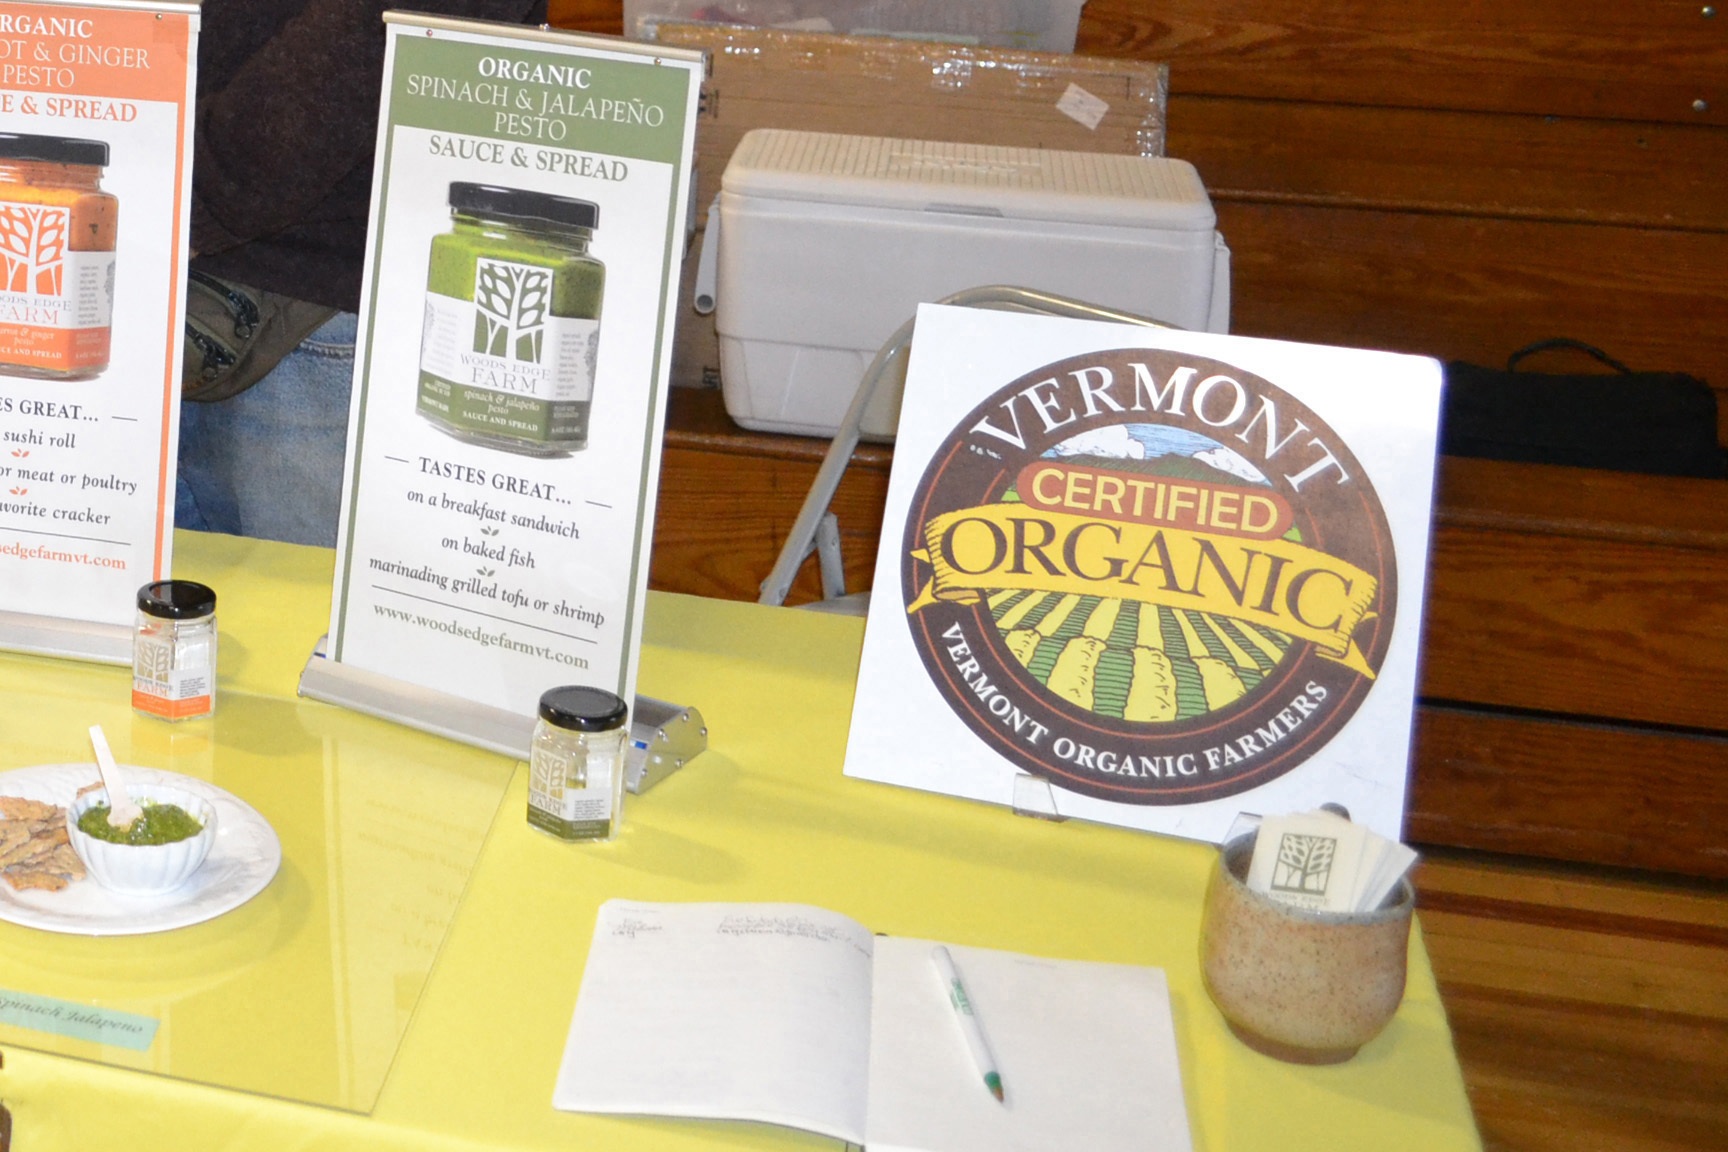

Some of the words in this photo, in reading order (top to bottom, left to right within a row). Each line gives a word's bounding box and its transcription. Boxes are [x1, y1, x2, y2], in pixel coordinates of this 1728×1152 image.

[33, 41, 50, 61] &
[59, 43, 150, 69] GINGER
[3, 64, 75, 88] PESTO
[478, 57, 591, 88] ORGANIC
[20, 96, 39, 115] &
[46, 97, 137, 122] SPREAD
[407, 73, 509, 107] SPINACH
[515, 88, 533, 110] &
[541, 90, 664, 127] JALAPEÑO
[494, 112, 566, 141] PESTO
[429, 135, 504, 164] SAUCE
[510, 147, 528, 168] &
[536, 149, 628, 182] SPREAD
[34, 298, 72, 311] EDGE
[14, 347, 31, 355] AND
[32, 350, 62, 358] SPREAD
[460, 353, 506, 369] WOODS
[512, 364, 551, 381] EDGE
[472, 367, 537, 394] FARM
[19, 400, 98, 422] GREAT...
[464, 390, 493, 404] spinach
[488, 403, 509, 414] pesto
[463, 411, 488, 422] SAUCE
[489, 416, 506, 425] AND
[508, 419, 538, 431] SPREAD
[970, 362, 1350, 494] VERMONT
[4, 429, 43, 445] sushi
[49, 434, 76, 448] roll
[18, 469, 54, 483] meat
[61, 473, 76, 484] or
[81, 473, 137, 495] poultry
[419, 457, 485, 485] TASTES
[492, 473, 571, 505] GREAT...
[407, 489, 424, 503] on
[428, 495, 437, 507] a
[441, 493, 506, 522] breakfast
[511, 514, 580, 540] sandwich
[1031, 467, 1278, 534] CERTIFIED
[53, 507, 110, 525] cracker
[442, 537, 458, 550] on
[463, 537, 505, 562] baked
[508, 548, 536, 569] fish
[940, 516, 1353, 632] ORGANIC
[369, 556, 448, 590] marinading
[451, 578, 497, 599] grilled
[502, 589, 529, 608] tofu
[534, 599, 549, 612] or
[553, 600, 604, 629] shrimp
[373, 604, 589, 669] www.woodsedgefarmvt.com
[941, 621, 1049, 745] VERMONT
[1053, 737, 1198, 778] ORGANIC
[1202, 680, 1328, 771] FARMERS
[531, 796, 561, 815] FARM
[62, 1010, 143, 1033] Jalapeno
